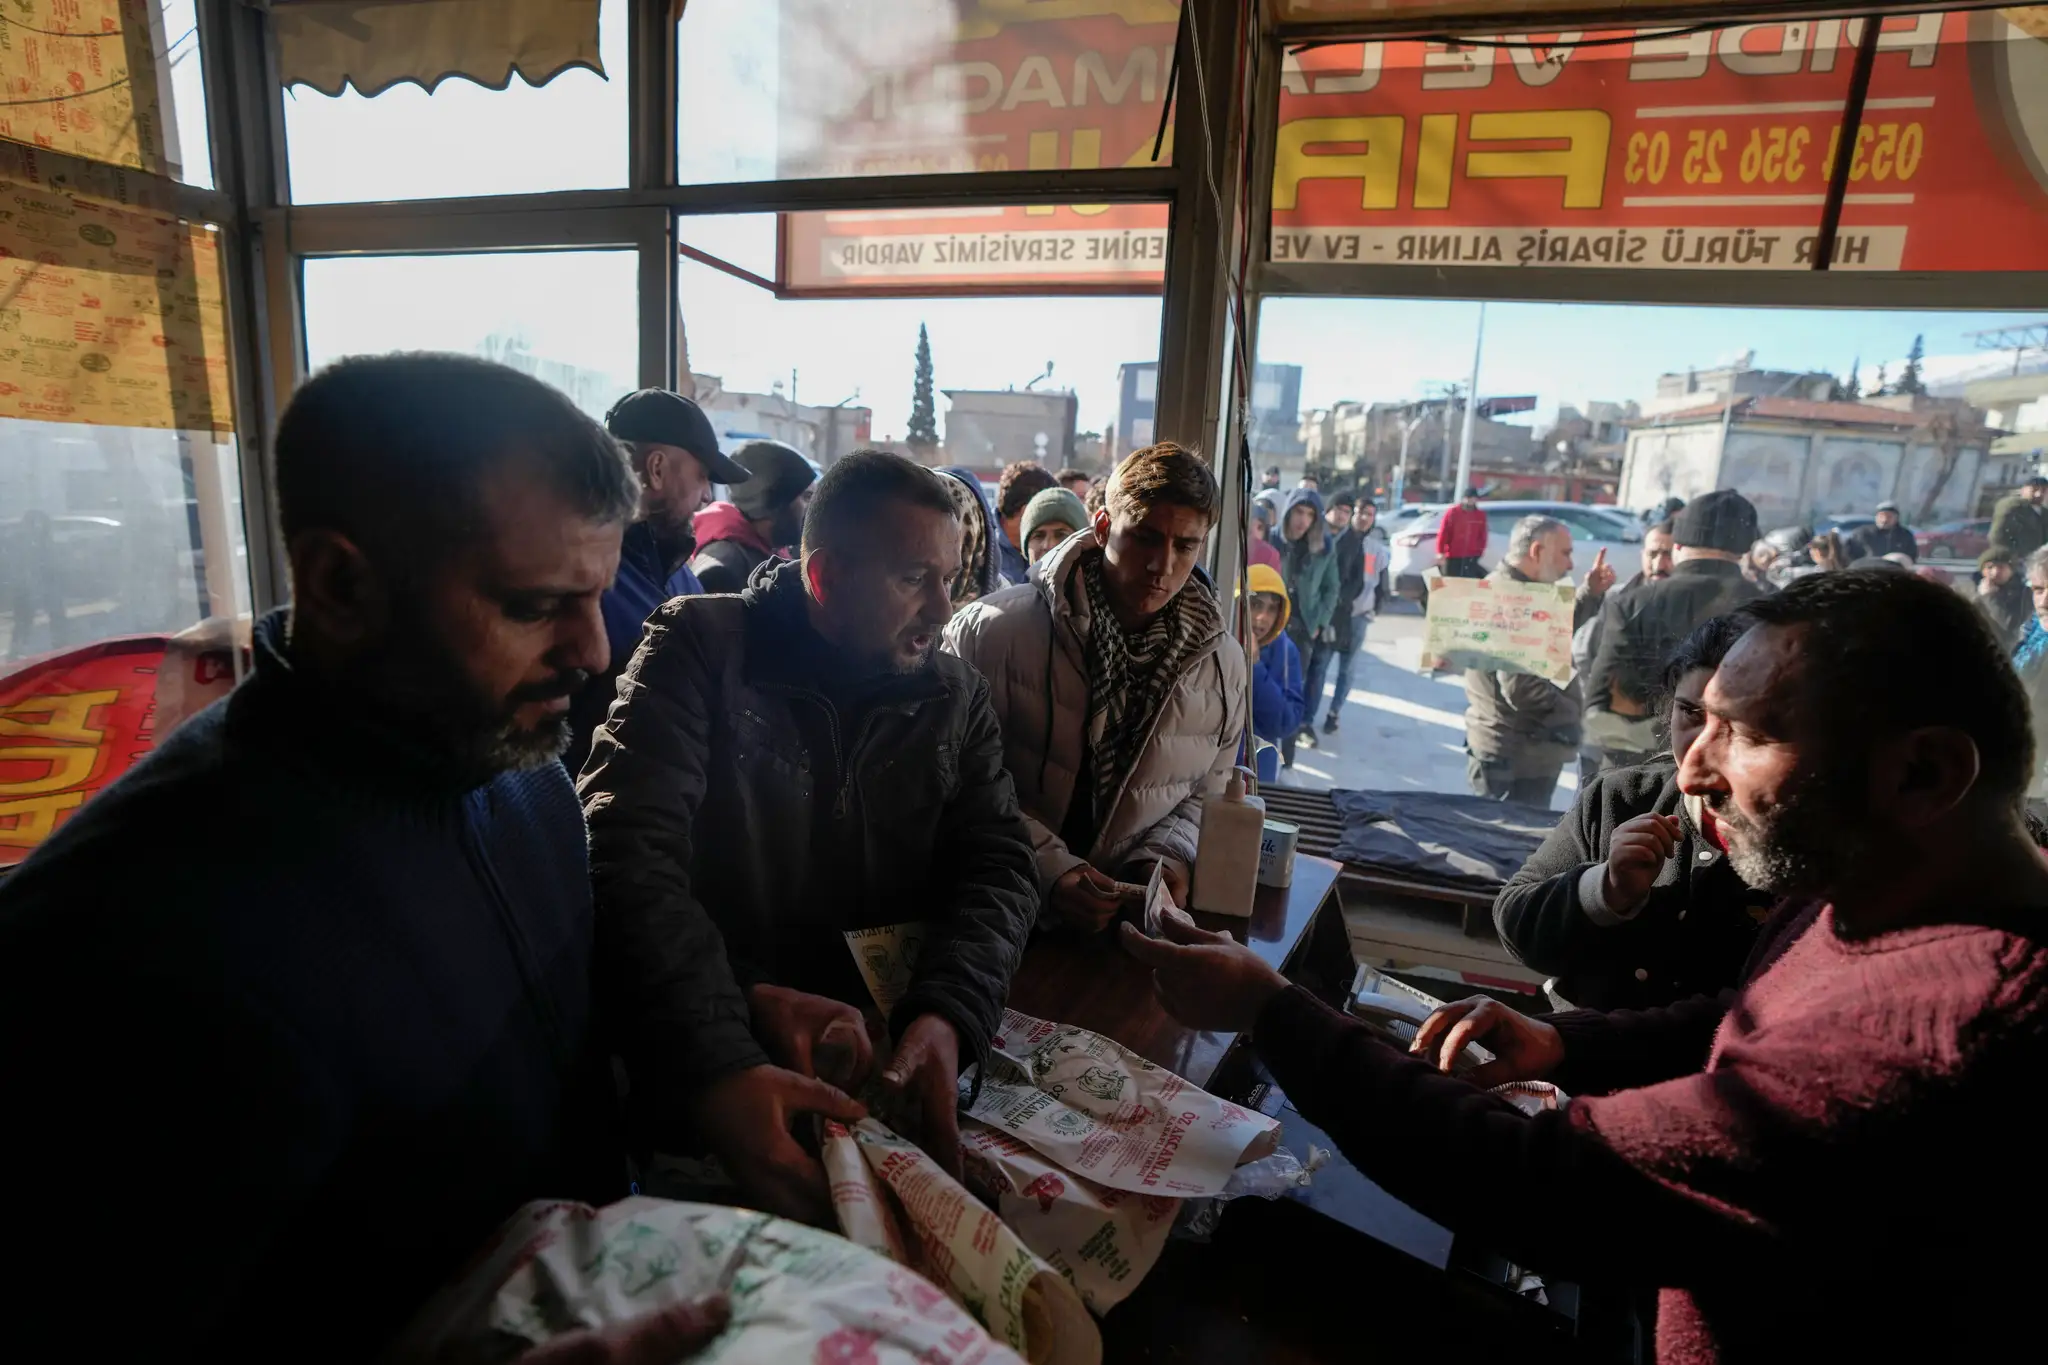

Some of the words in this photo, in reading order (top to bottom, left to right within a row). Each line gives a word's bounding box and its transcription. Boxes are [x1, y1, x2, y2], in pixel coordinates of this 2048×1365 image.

[1261, 839, 1276, 852] ik
[1247, 1083, 1262, 1103] ADA
[1177, 1111, 1200, 1127] ÖZ
[1141, 1124, 1184, 1187] AKCANLAR
